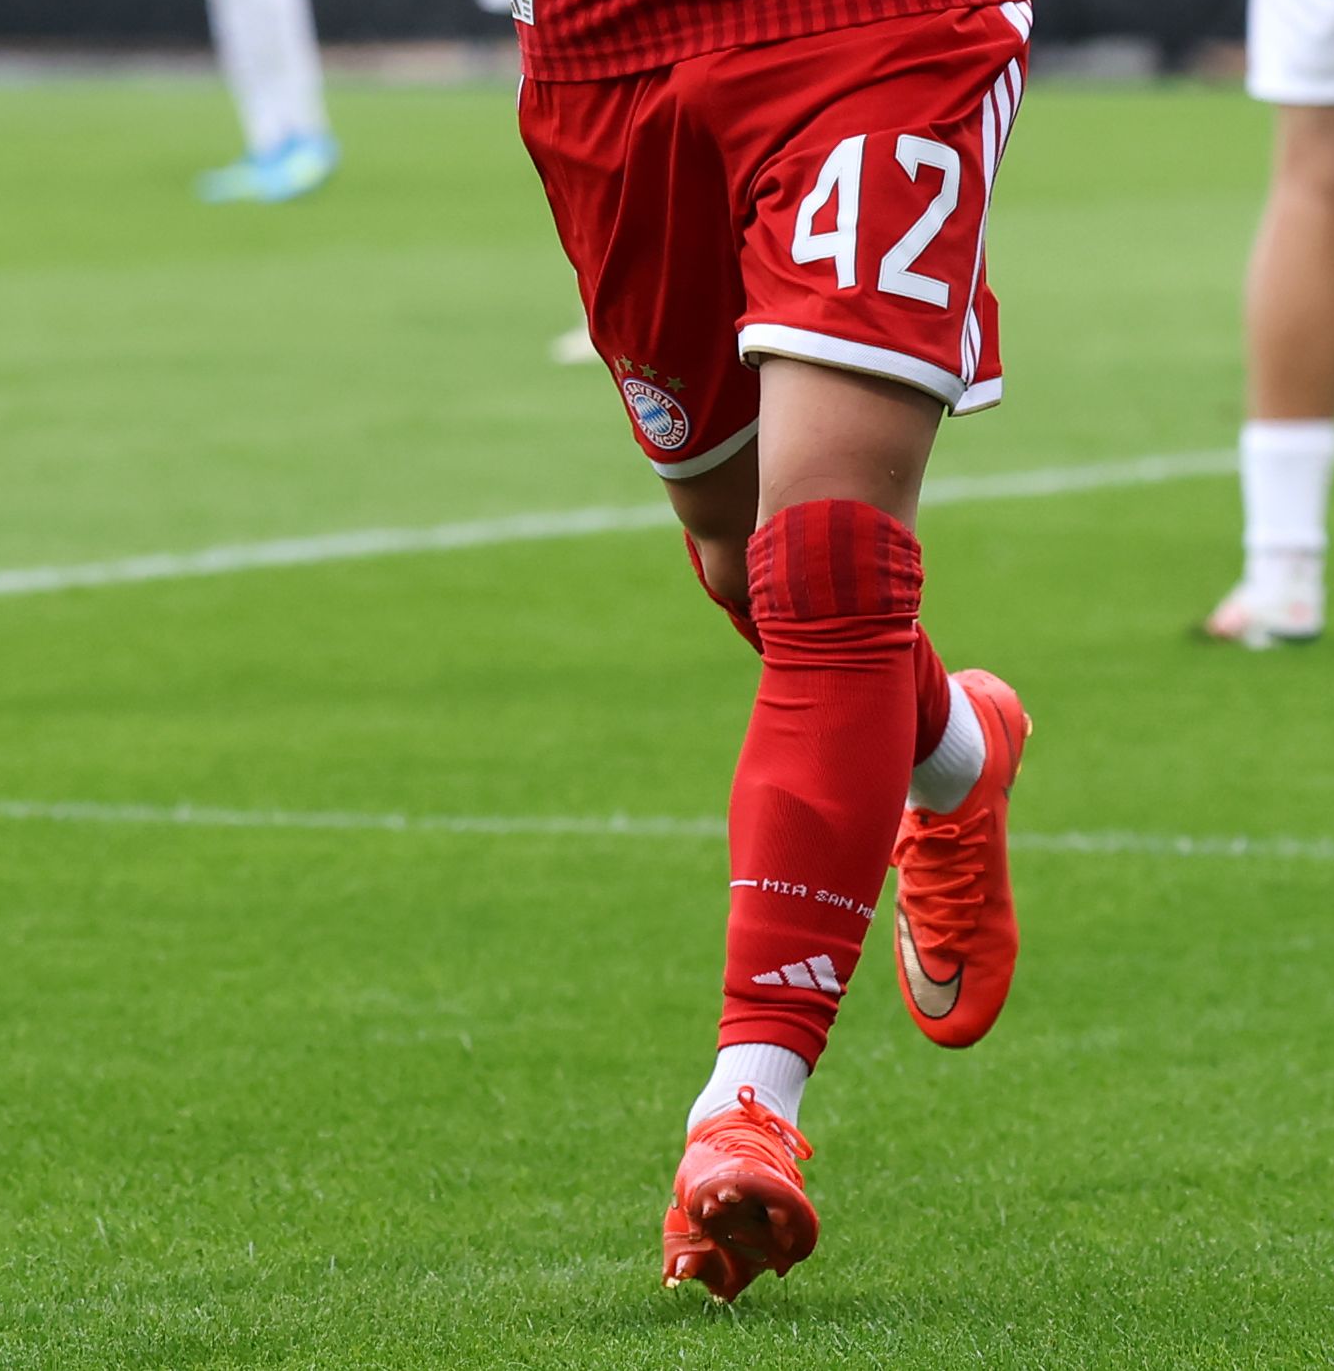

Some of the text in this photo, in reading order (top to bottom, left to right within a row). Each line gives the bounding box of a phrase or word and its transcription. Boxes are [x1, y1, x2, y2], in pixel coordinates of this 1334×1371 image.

[792, 133, 963, 311] 42
[762, 878, 808, 898] MIA
[814, 889, 854, 911] SAN
